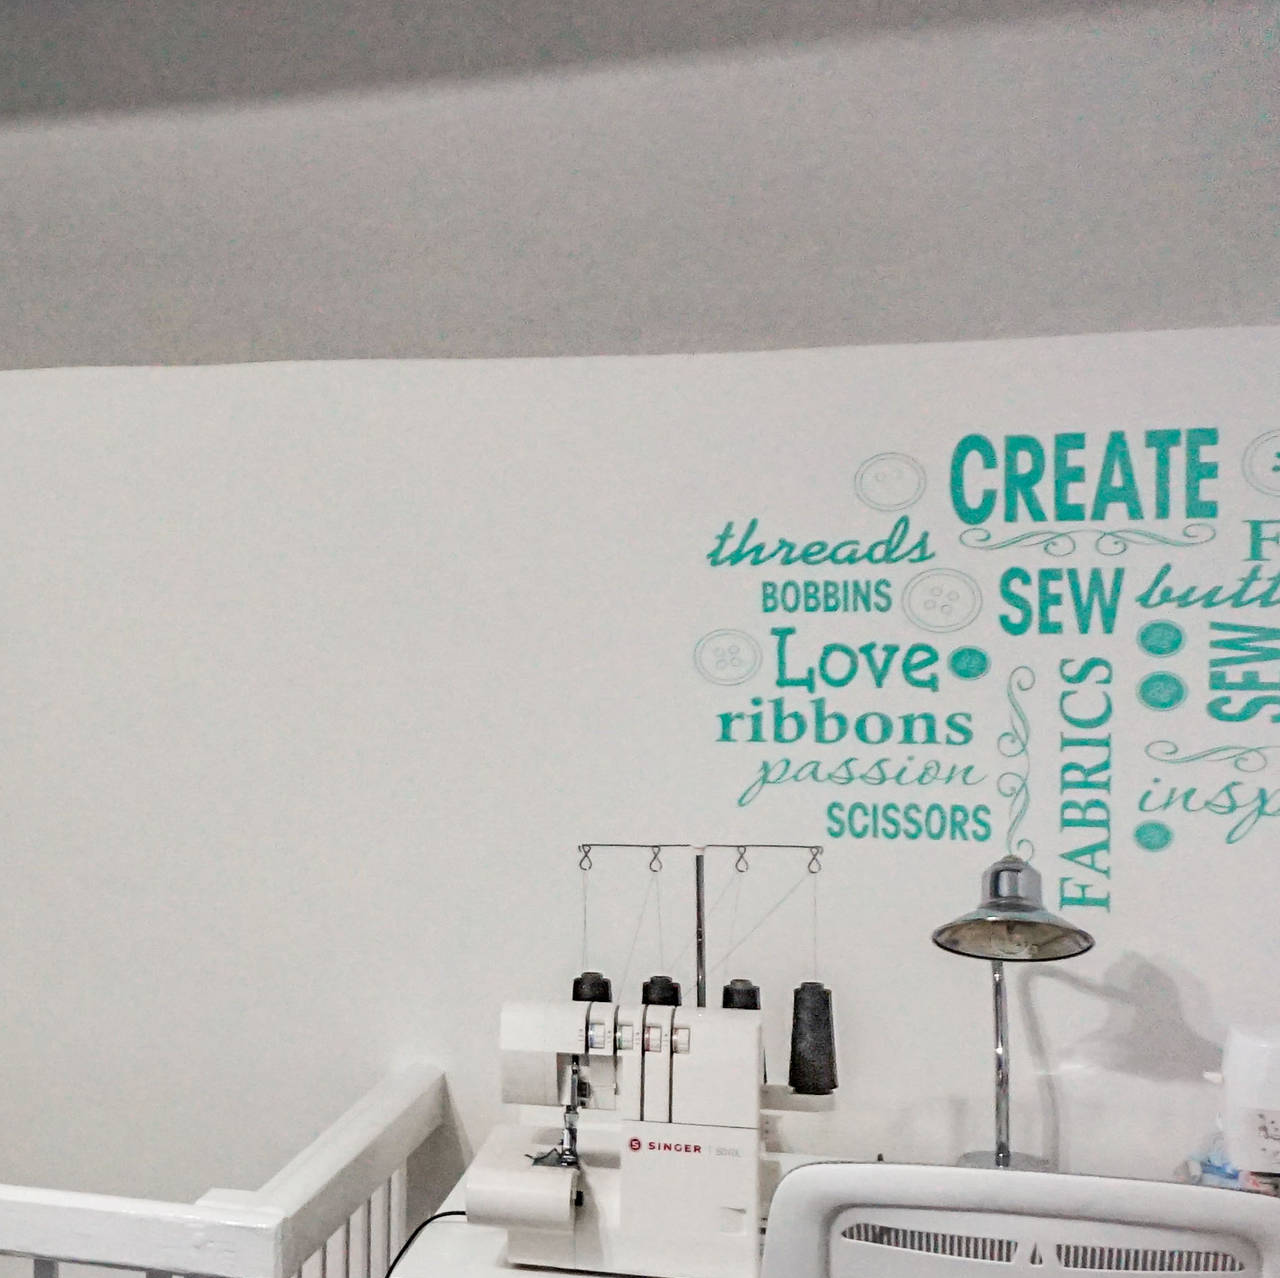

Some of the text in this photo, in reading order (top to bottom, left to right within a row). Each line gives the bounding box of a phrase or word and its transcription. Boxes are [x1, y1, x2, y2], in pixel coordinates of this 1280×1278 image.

[948, 426, 1221, 527] CREATE
[706, 513, 937, 569] threads
[760, 578, 894, 614] BOBBINS
[997, 566, 1126, 637] SEW
[769, 625, 941, 695] Love
[1206, 620, 1280, 725] SEW
[715, 696, 974, 747] ribbons
[737, 754, 987, 808] passion
[1057, 656, 1114, 913] FABRICS
[824, 800, 993, 842] SCISSORS
[647, 1140, 703, 1154] SINGER
